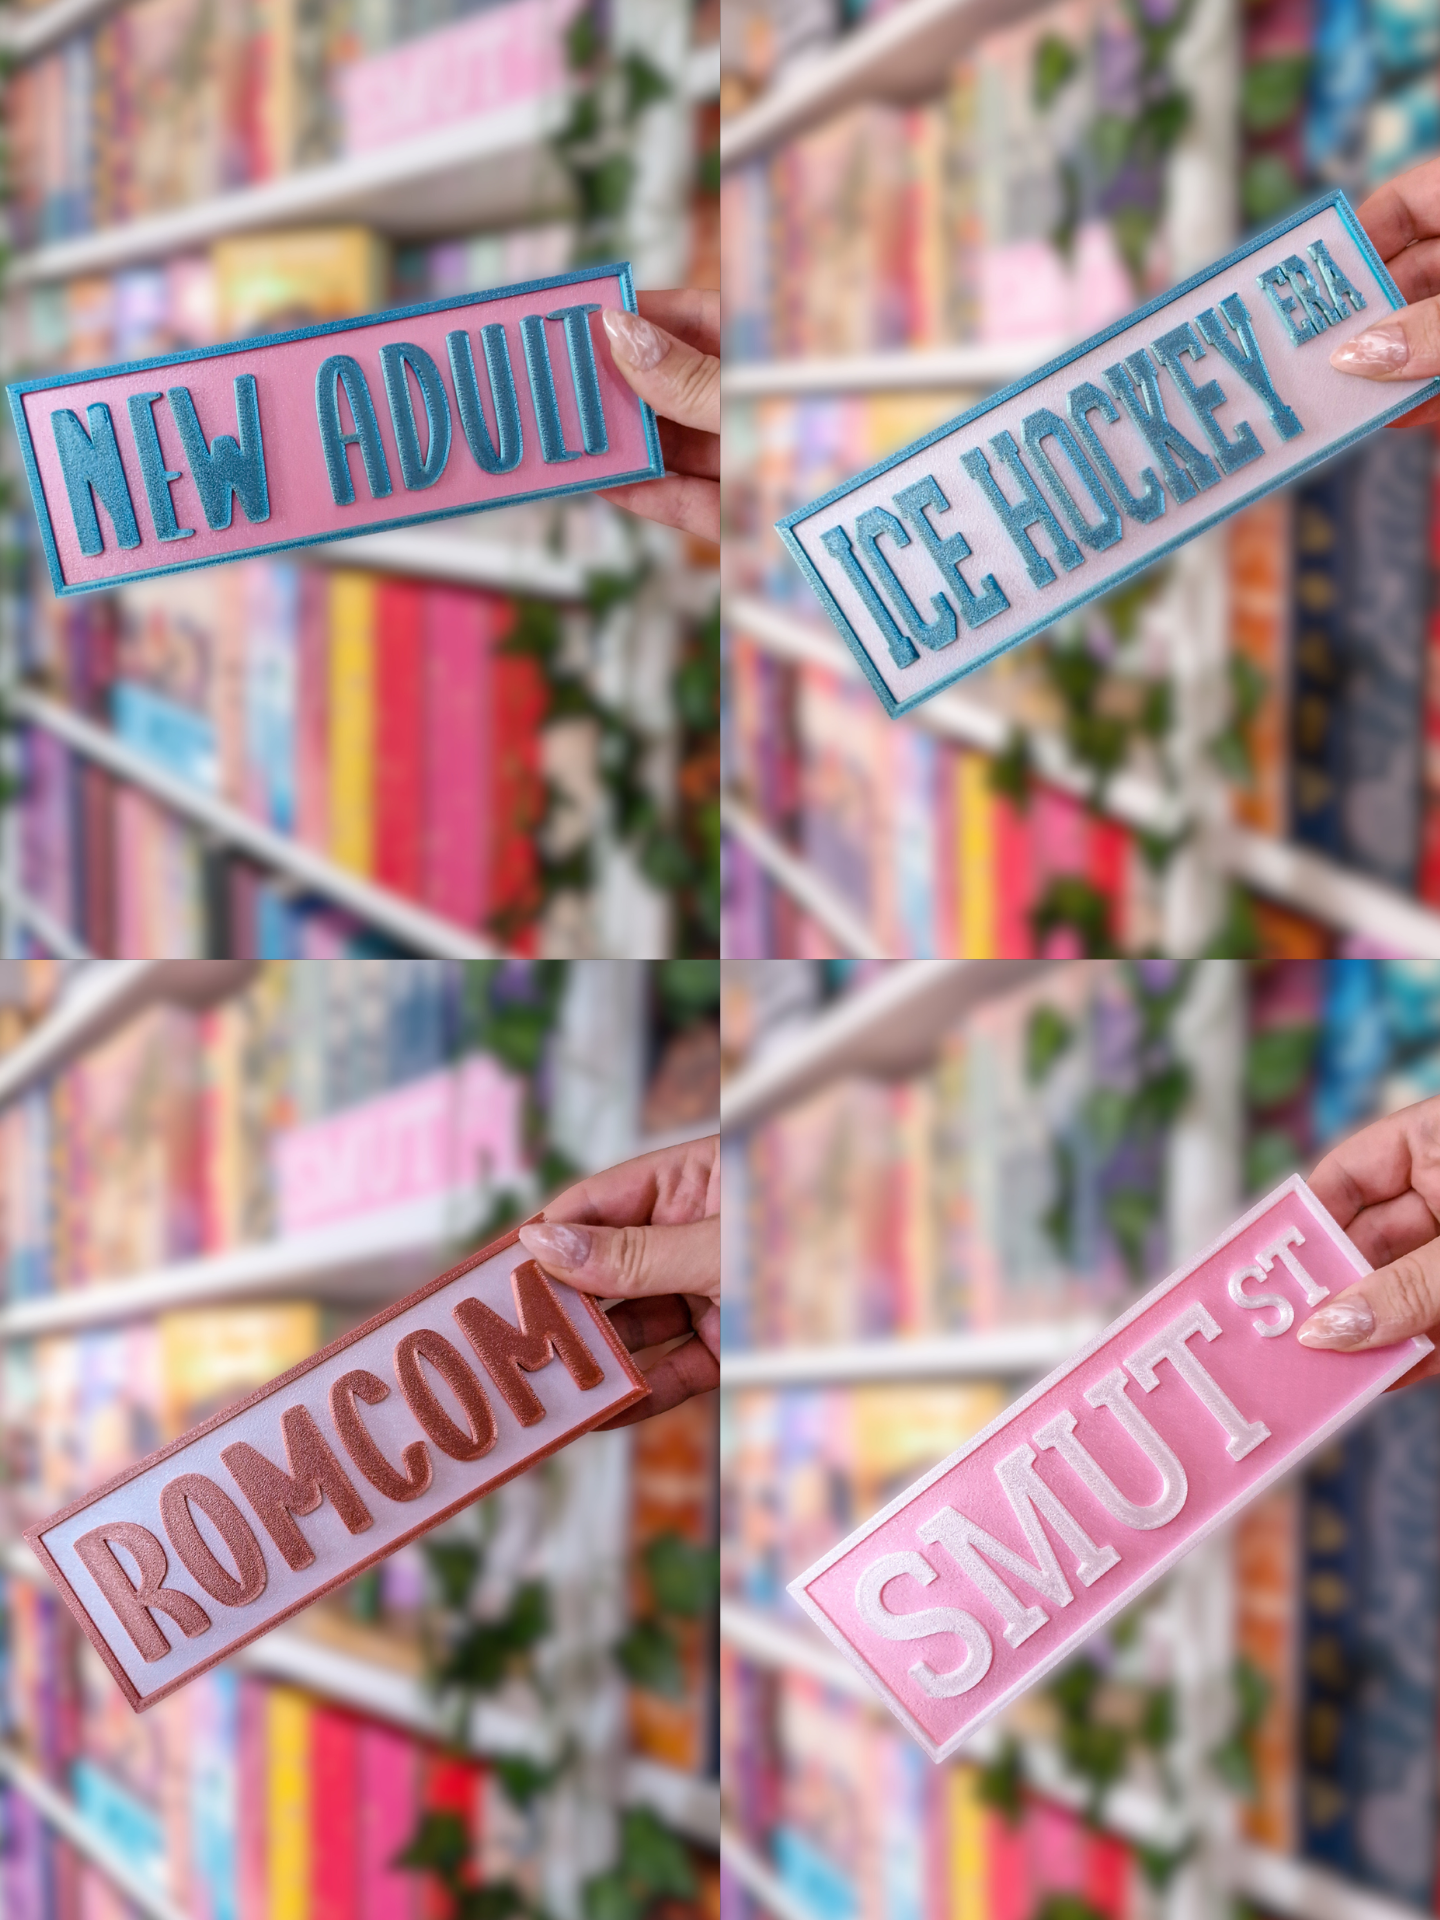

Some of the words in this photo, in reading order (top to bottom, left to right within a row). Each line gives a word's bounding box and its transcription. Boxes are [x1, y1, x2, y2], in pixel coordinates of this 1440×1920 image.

[50, 373, 271, 557] NEW
[314, 303, 609, 506] ADULT
[819, 474, 1011, 670] ICE
[960, 292, 1306, 590] HOCKEY
[1255, 239, 1367, 348] ERA
[73, 1259, 605, 1663] ROMCOM
[854, 1301, 1272, 1698] SMUT
[1227, 1225, 1331, 1338] ST
